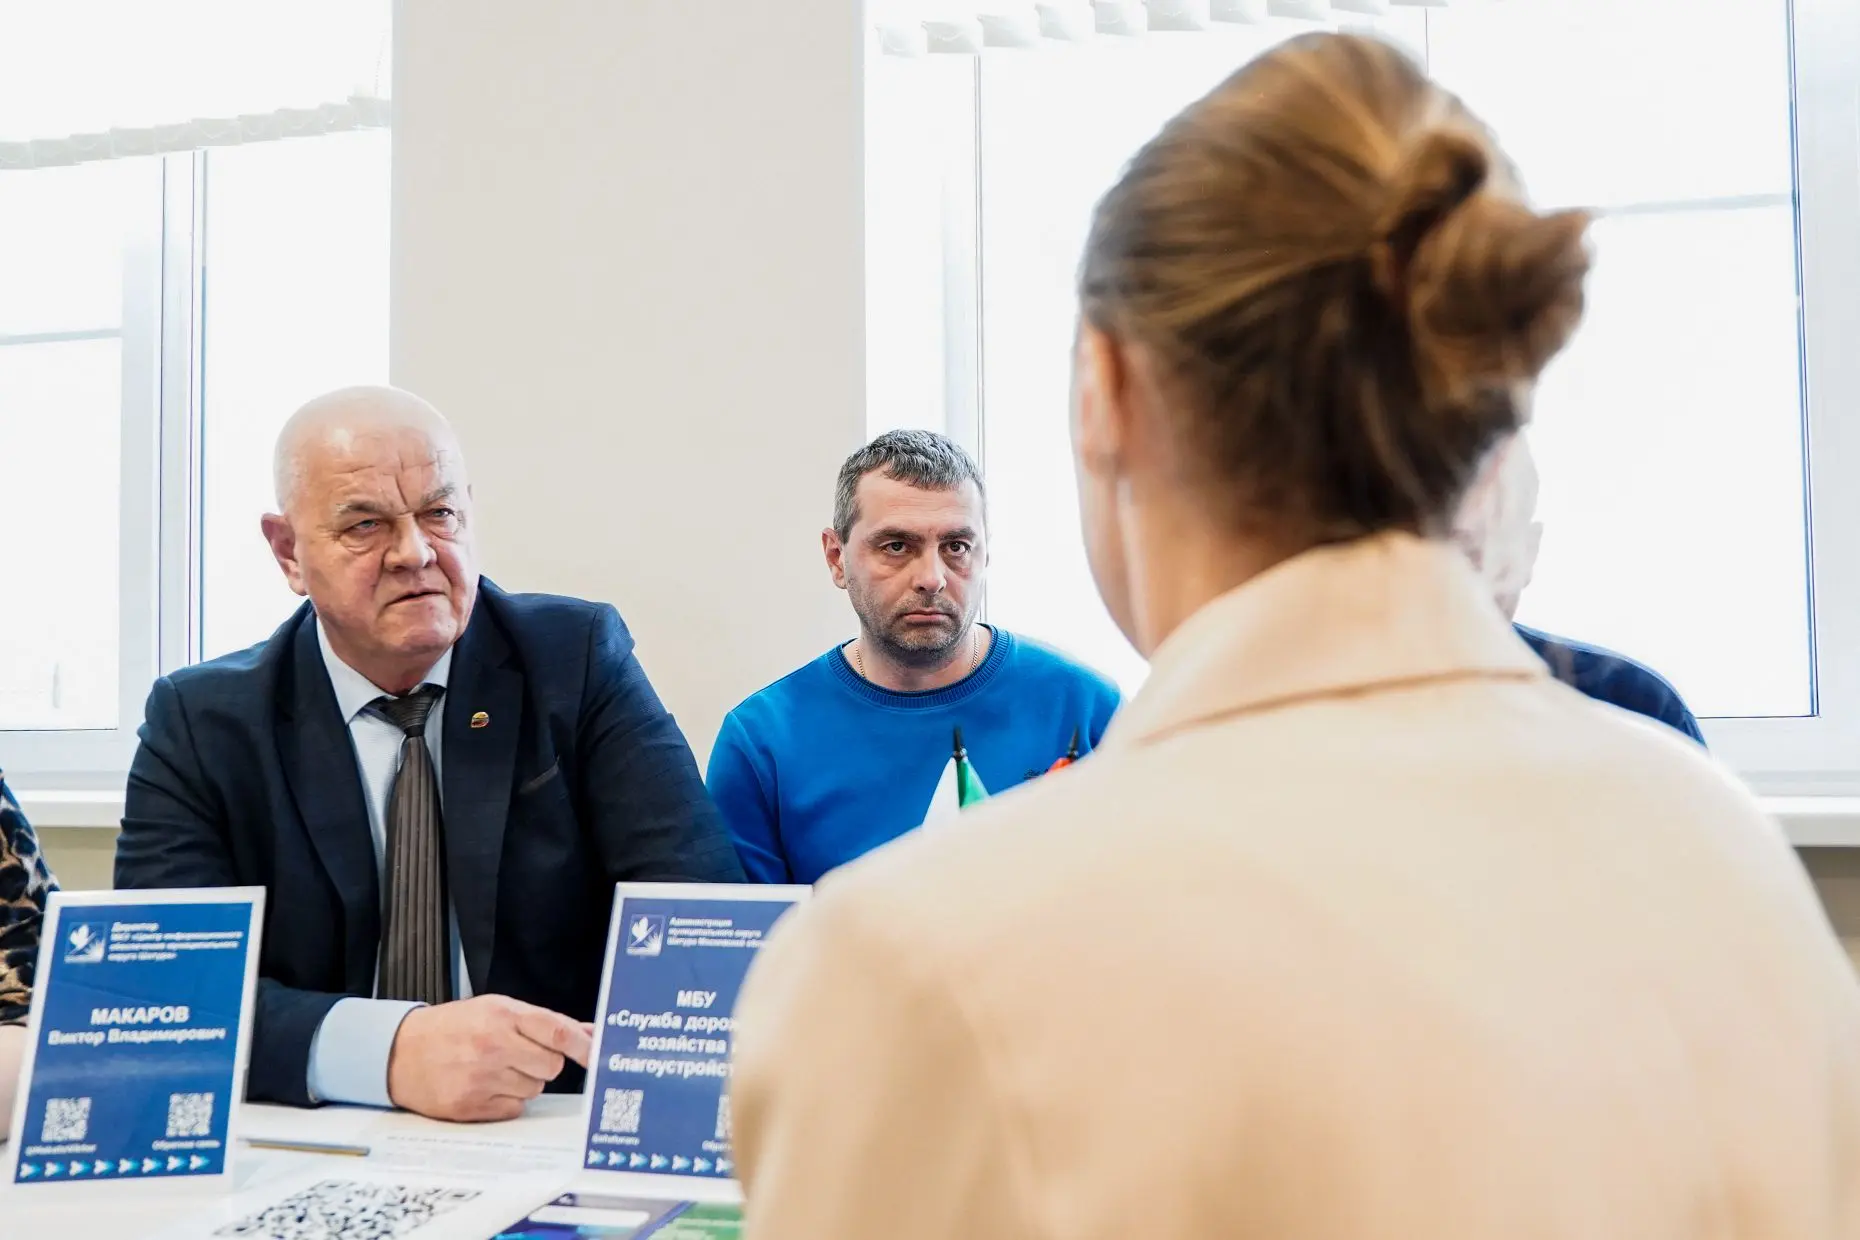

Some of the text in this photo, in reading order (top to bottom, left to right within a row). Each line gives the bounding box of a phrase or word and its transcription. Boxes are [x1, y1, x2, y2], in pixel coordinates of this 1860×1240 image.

[676, 989, 717, 1008] МБУ
[90, 1006, 190, 1025] МАКАРОВ
[607, 1009, 683, 1032] «Служба
[48, 1028, 227, 1047] Виктор Владимирович
[637, 1035, 727, 1053] хозяйства
